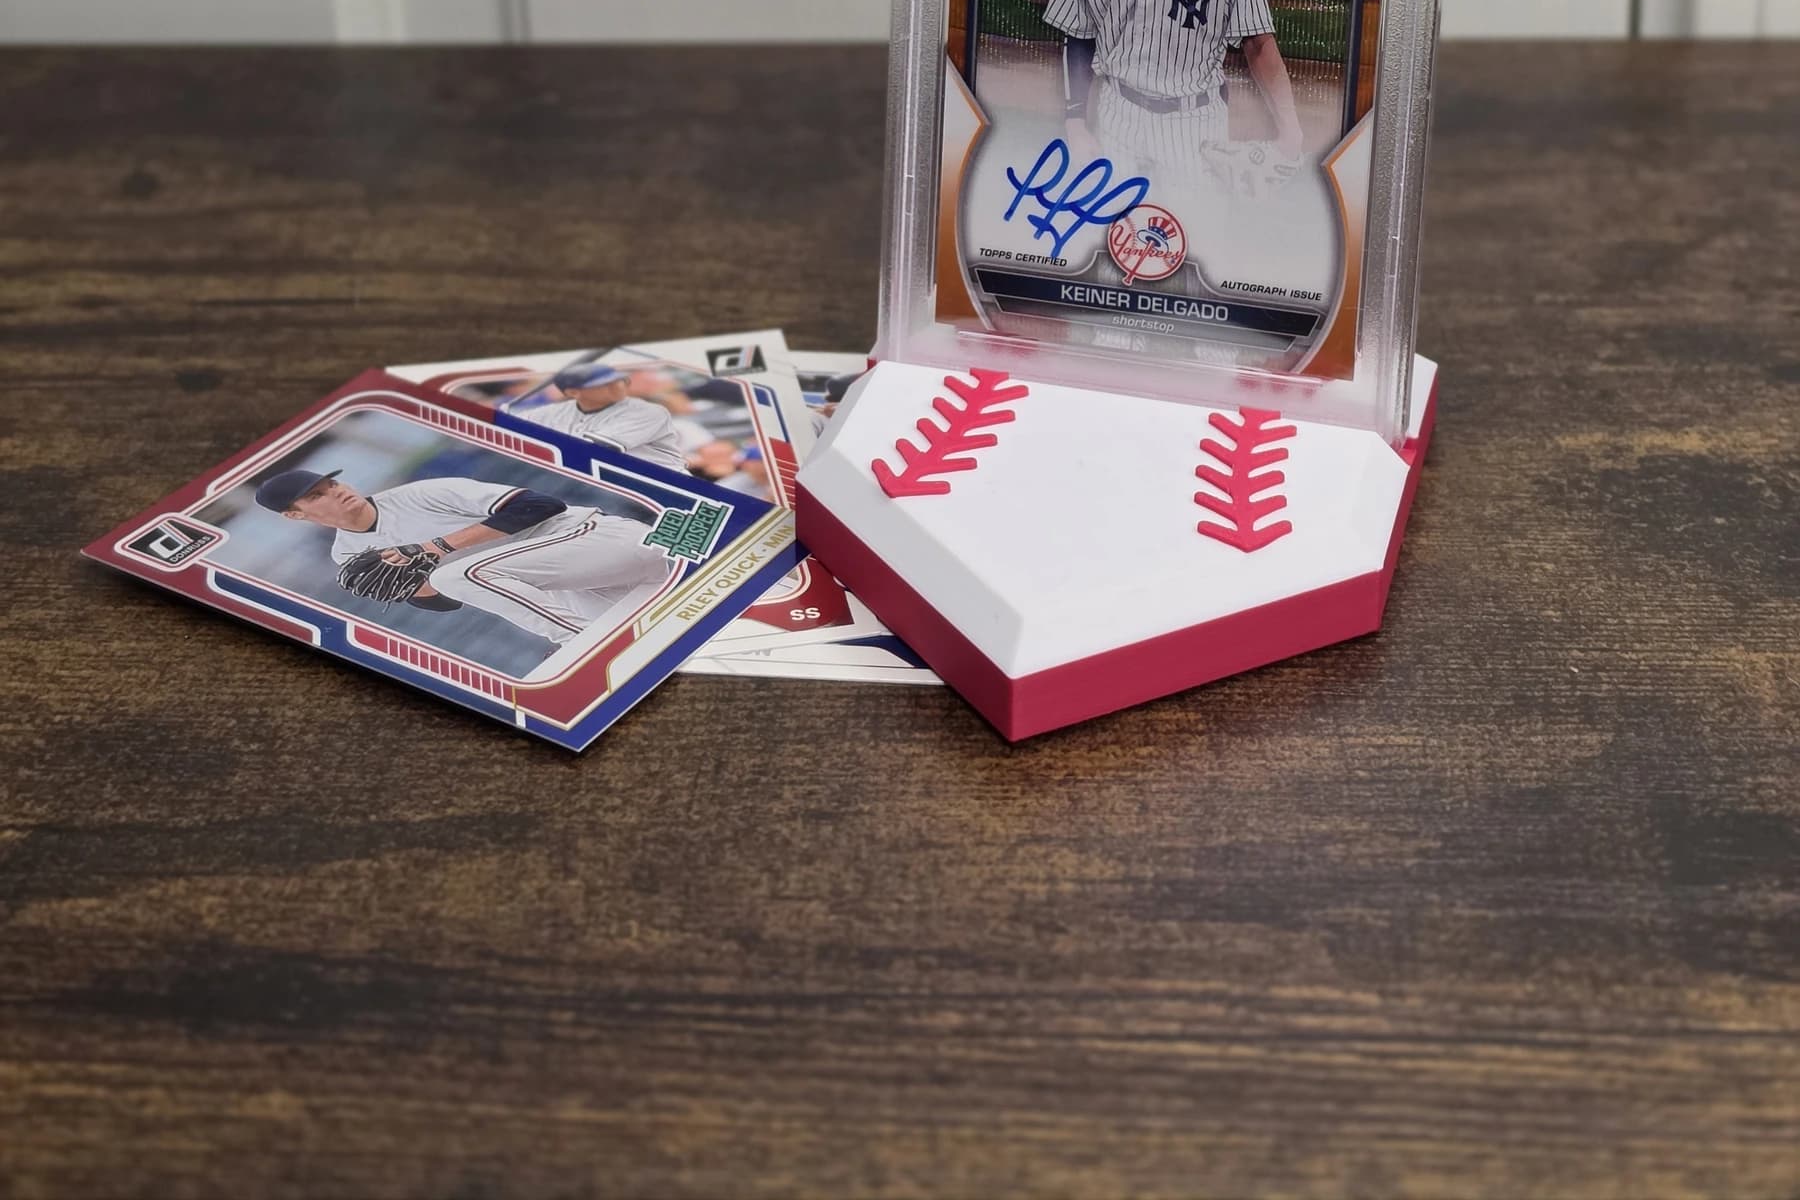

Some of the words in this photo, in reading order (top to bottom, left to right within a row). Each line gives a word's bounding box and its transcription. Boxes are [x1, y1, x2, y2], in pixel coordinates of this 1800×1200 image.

[979, 248, 1012, 260] TOPPS
[1015, 252, 1068, 268] CERTIFIED
[1112, 224, 1185, 261] Yankees
[1061, 285, 1130, 309] KEINER
[1137, 295, 1229, 322] DELGADO
[1220, 280, 1287, 297] AUTOGRAPH
[1289, 289, 1323, 301] ISSUE
[1111, 315, 1175, 334] shortstop
[643, 509, 688, 548] RATED
[667, 501, 722, 560] PROSPECT
[169, 536, 211, 563] DONRUSS
[676, 588, 718, 621] RILEY
[715, 550, 764, 591] QUICK
